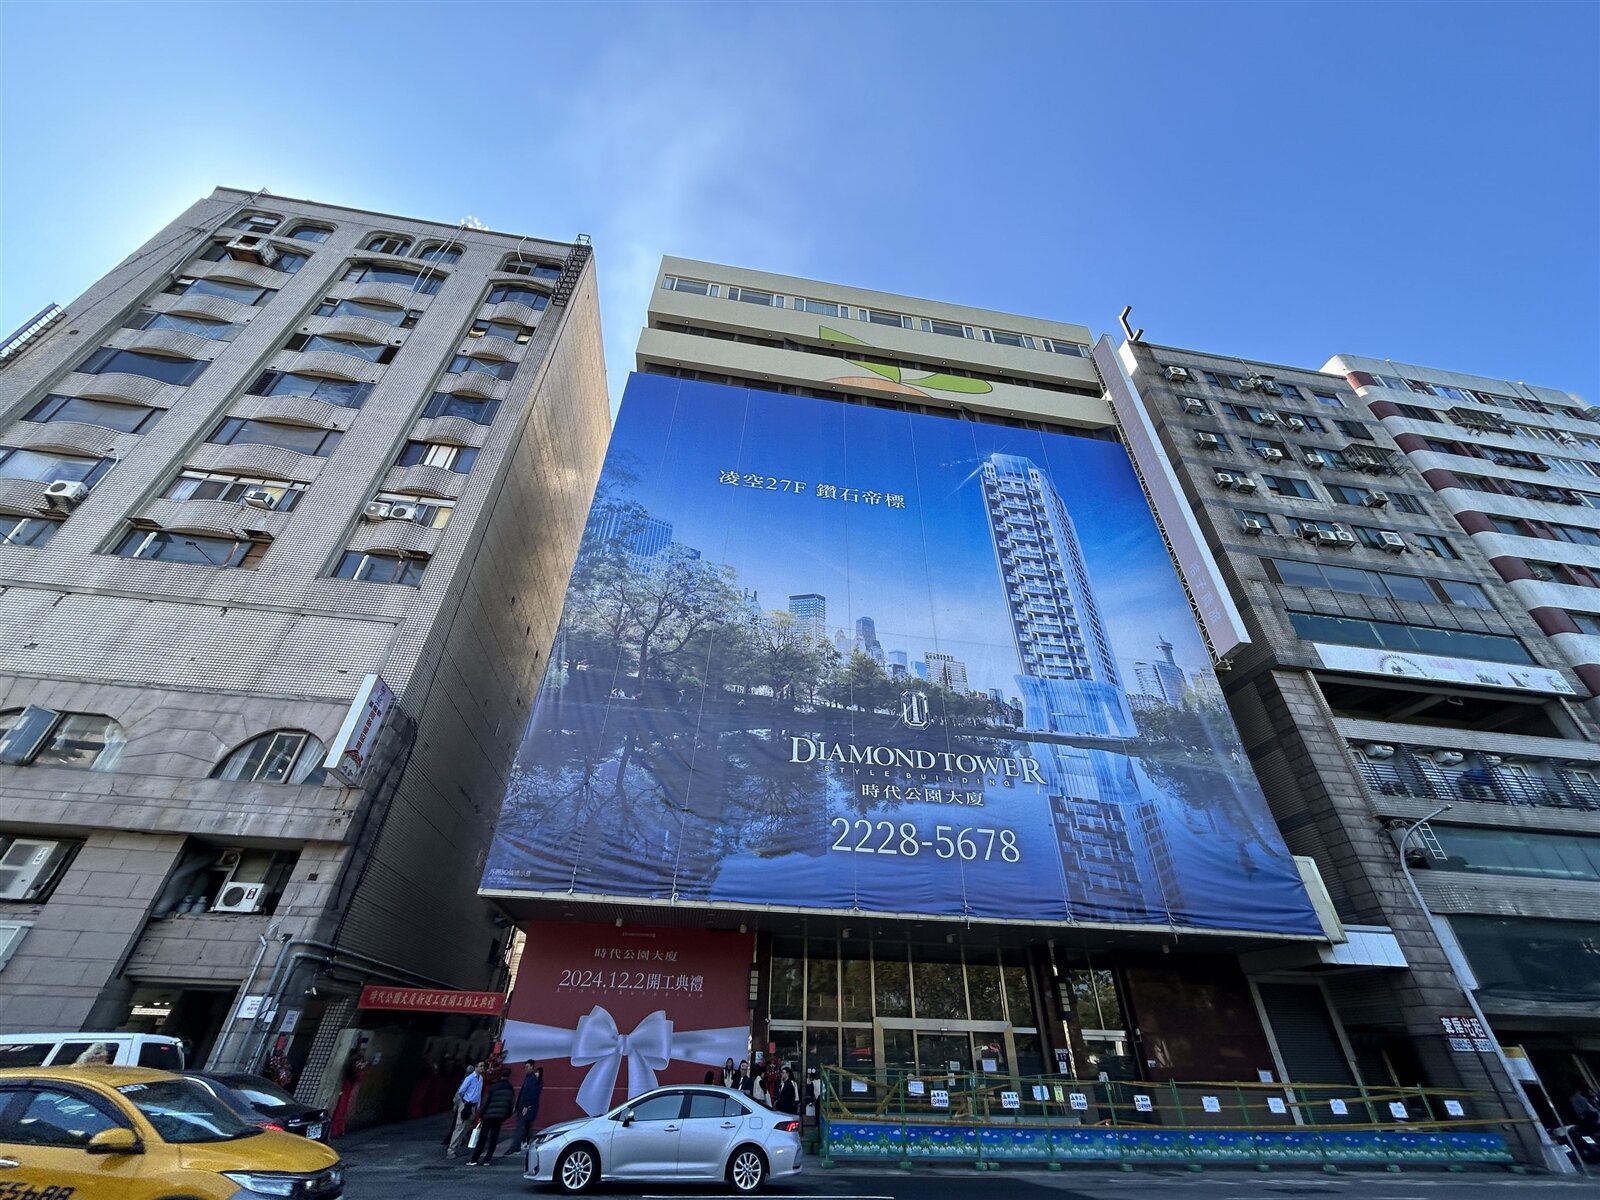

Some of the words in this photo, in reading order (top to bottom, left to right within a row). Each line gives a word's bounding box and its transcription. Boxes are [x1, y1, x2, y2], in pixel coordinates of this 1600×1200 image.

[815, 482, 906, 509] 鑽石帝標
[824, 765, 890, 777] STYLE
[906, 772, 1011, 787] BUILDING
[861, 783, 985, 807] 時代公園大廈
[831, 817, 1021, 863] 2228-5678
[594, 947, 679, 963] 時代公園大廈
